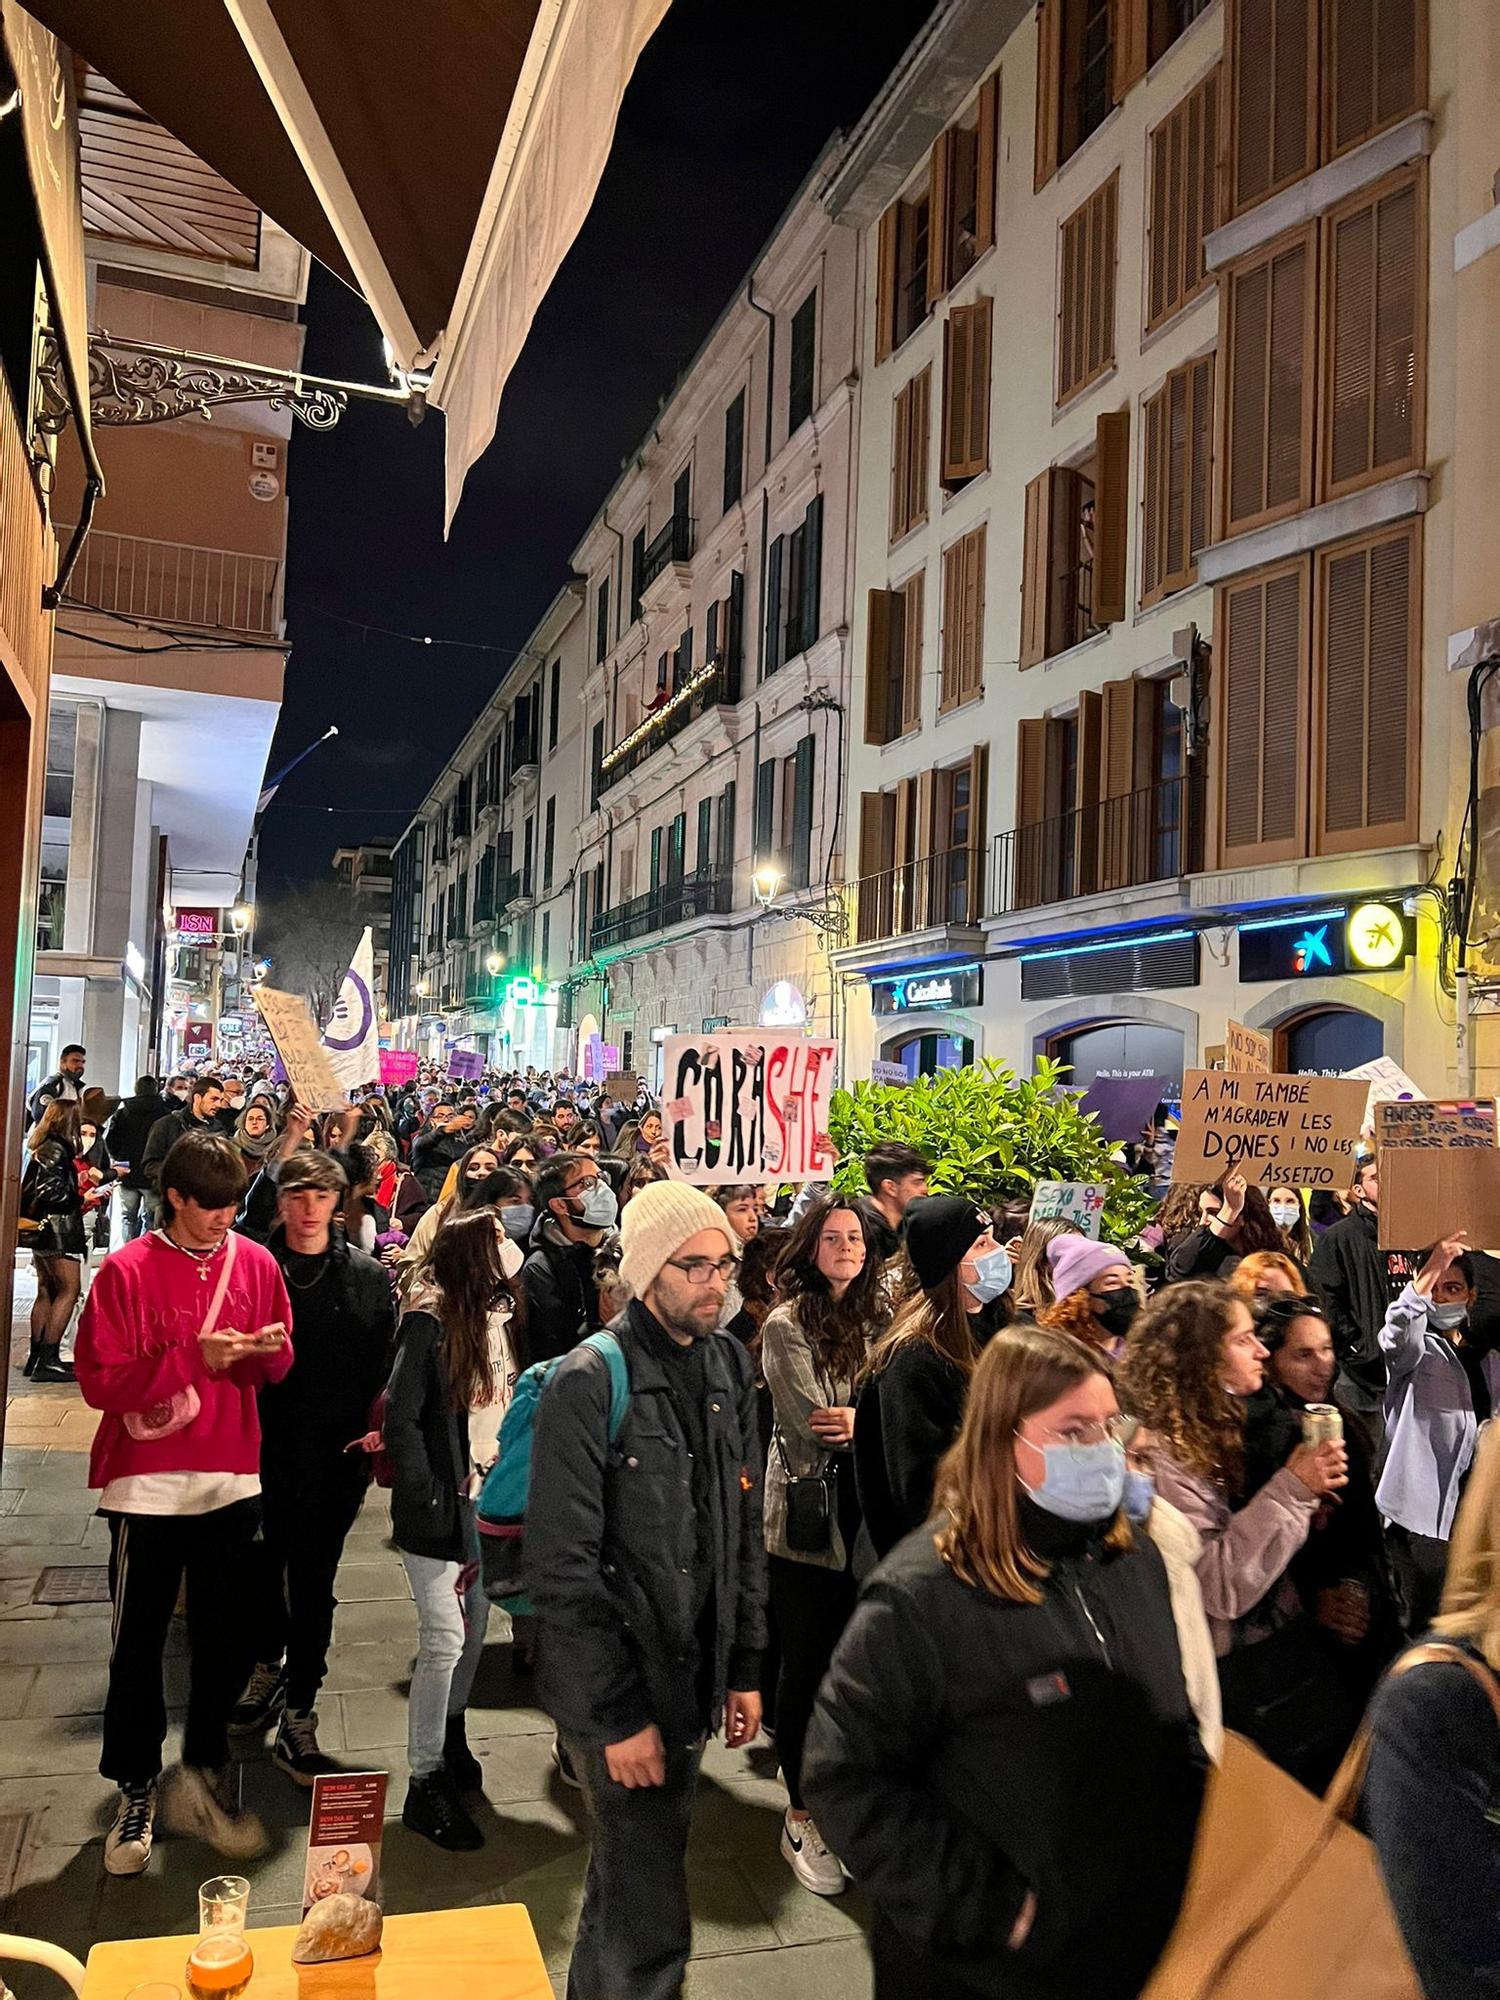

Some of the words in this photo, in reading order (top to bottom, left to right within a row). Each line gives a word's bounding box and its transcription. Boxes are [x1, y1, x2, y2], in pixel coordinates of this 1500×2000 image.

[1321, 1069, 1338, 1078] This
[1192, 1077, 1209, 1101] A
[1220, 1079, 1239, 1100] MI
[1255, 1081, 1312, 1104] TAMBÉ
[1204, 1105, 1289, 1128] M'AGRADEN
[1300, 1113, 1333, 1130] LES
[1203, 1130, 1280, 1167] DONES
[1305, 1136, 1328, 1154] NO
[1333, 1139, 1353, 1156] LES
[1259, 1162, 1334, 1184] ASSETJO
